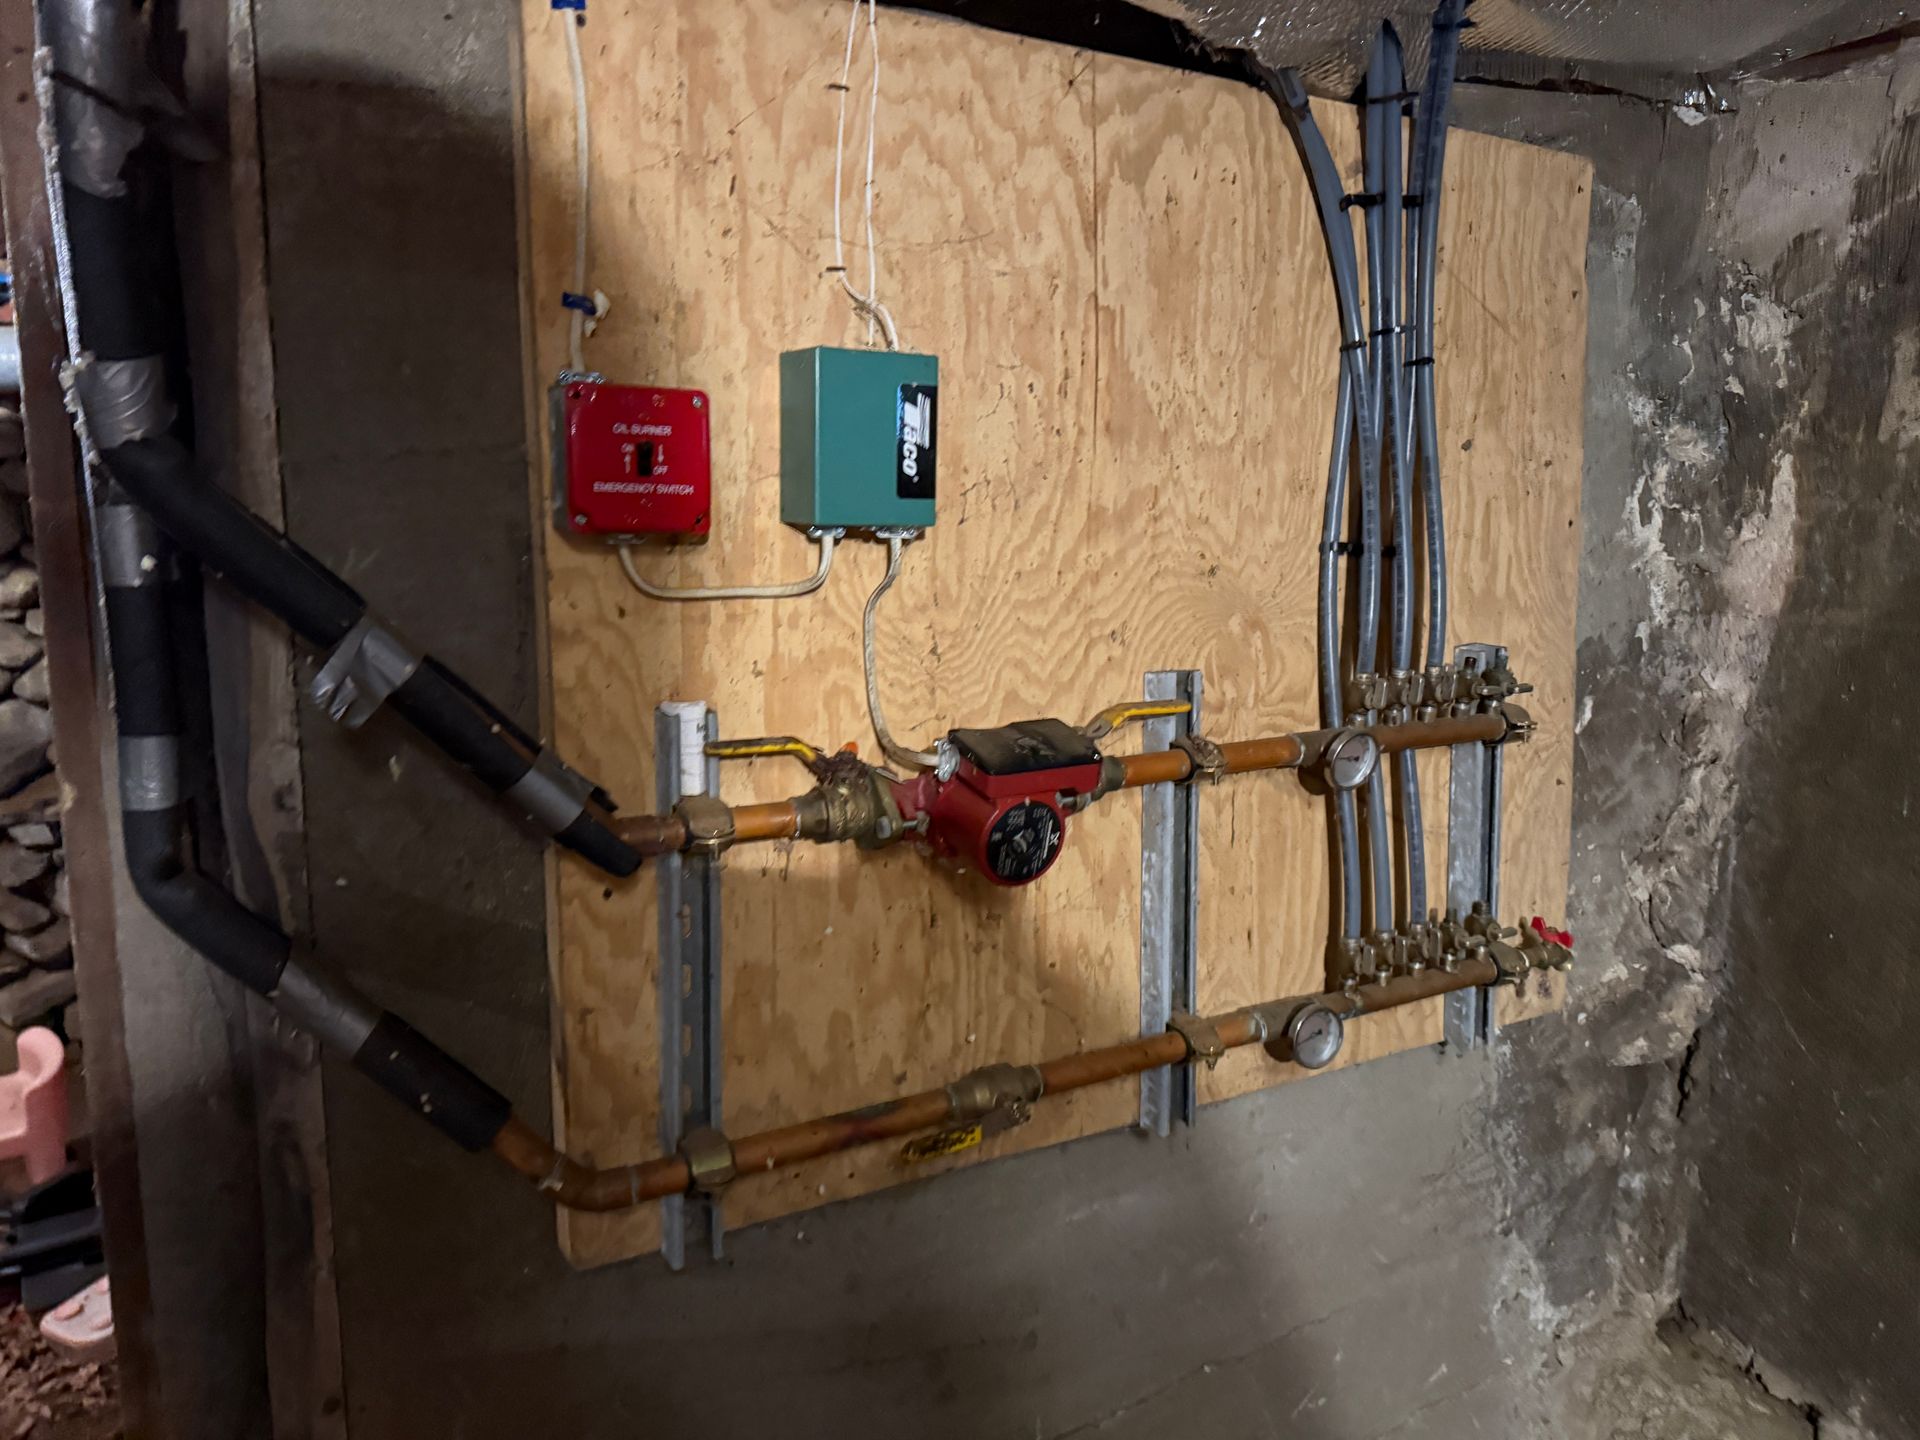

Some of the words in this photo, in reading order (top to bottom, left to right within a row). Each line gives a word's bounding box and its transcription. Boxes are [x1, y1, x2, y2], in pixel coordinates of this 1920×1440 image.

[612, 422, 629, 434] OIL
[631, 423, 672, 436] BURNER
[903, 392, 931, 477] Taco
[653, 465, 668, 475] OFF
[593, 481, 655, 495] EMERGENCY
[656, 483, 694, 496] SWITCH
